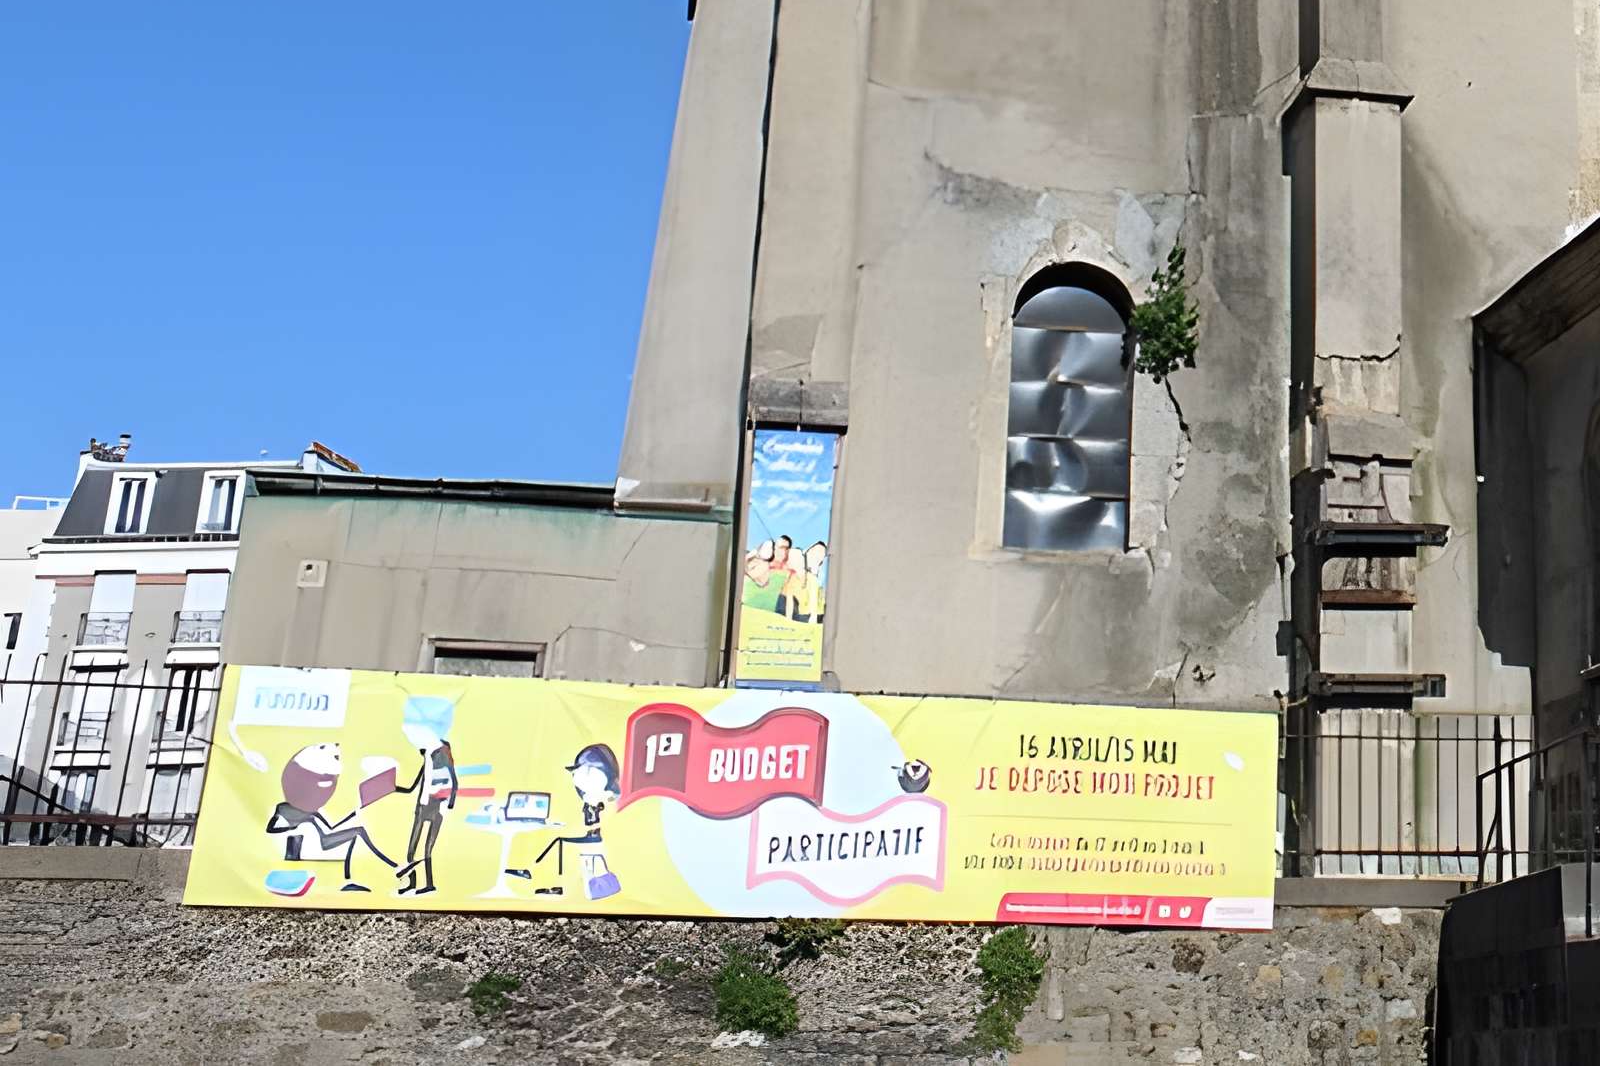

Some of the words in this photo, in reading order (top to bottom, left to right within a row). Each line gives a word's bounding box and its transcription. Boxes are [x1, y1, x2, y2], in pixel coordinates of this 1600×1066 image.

[707, 744, 811, 783] BUDGET
[1019, 734, 1039, 759] 16
[767, 826, 925, 865] PARTICIPATIF
